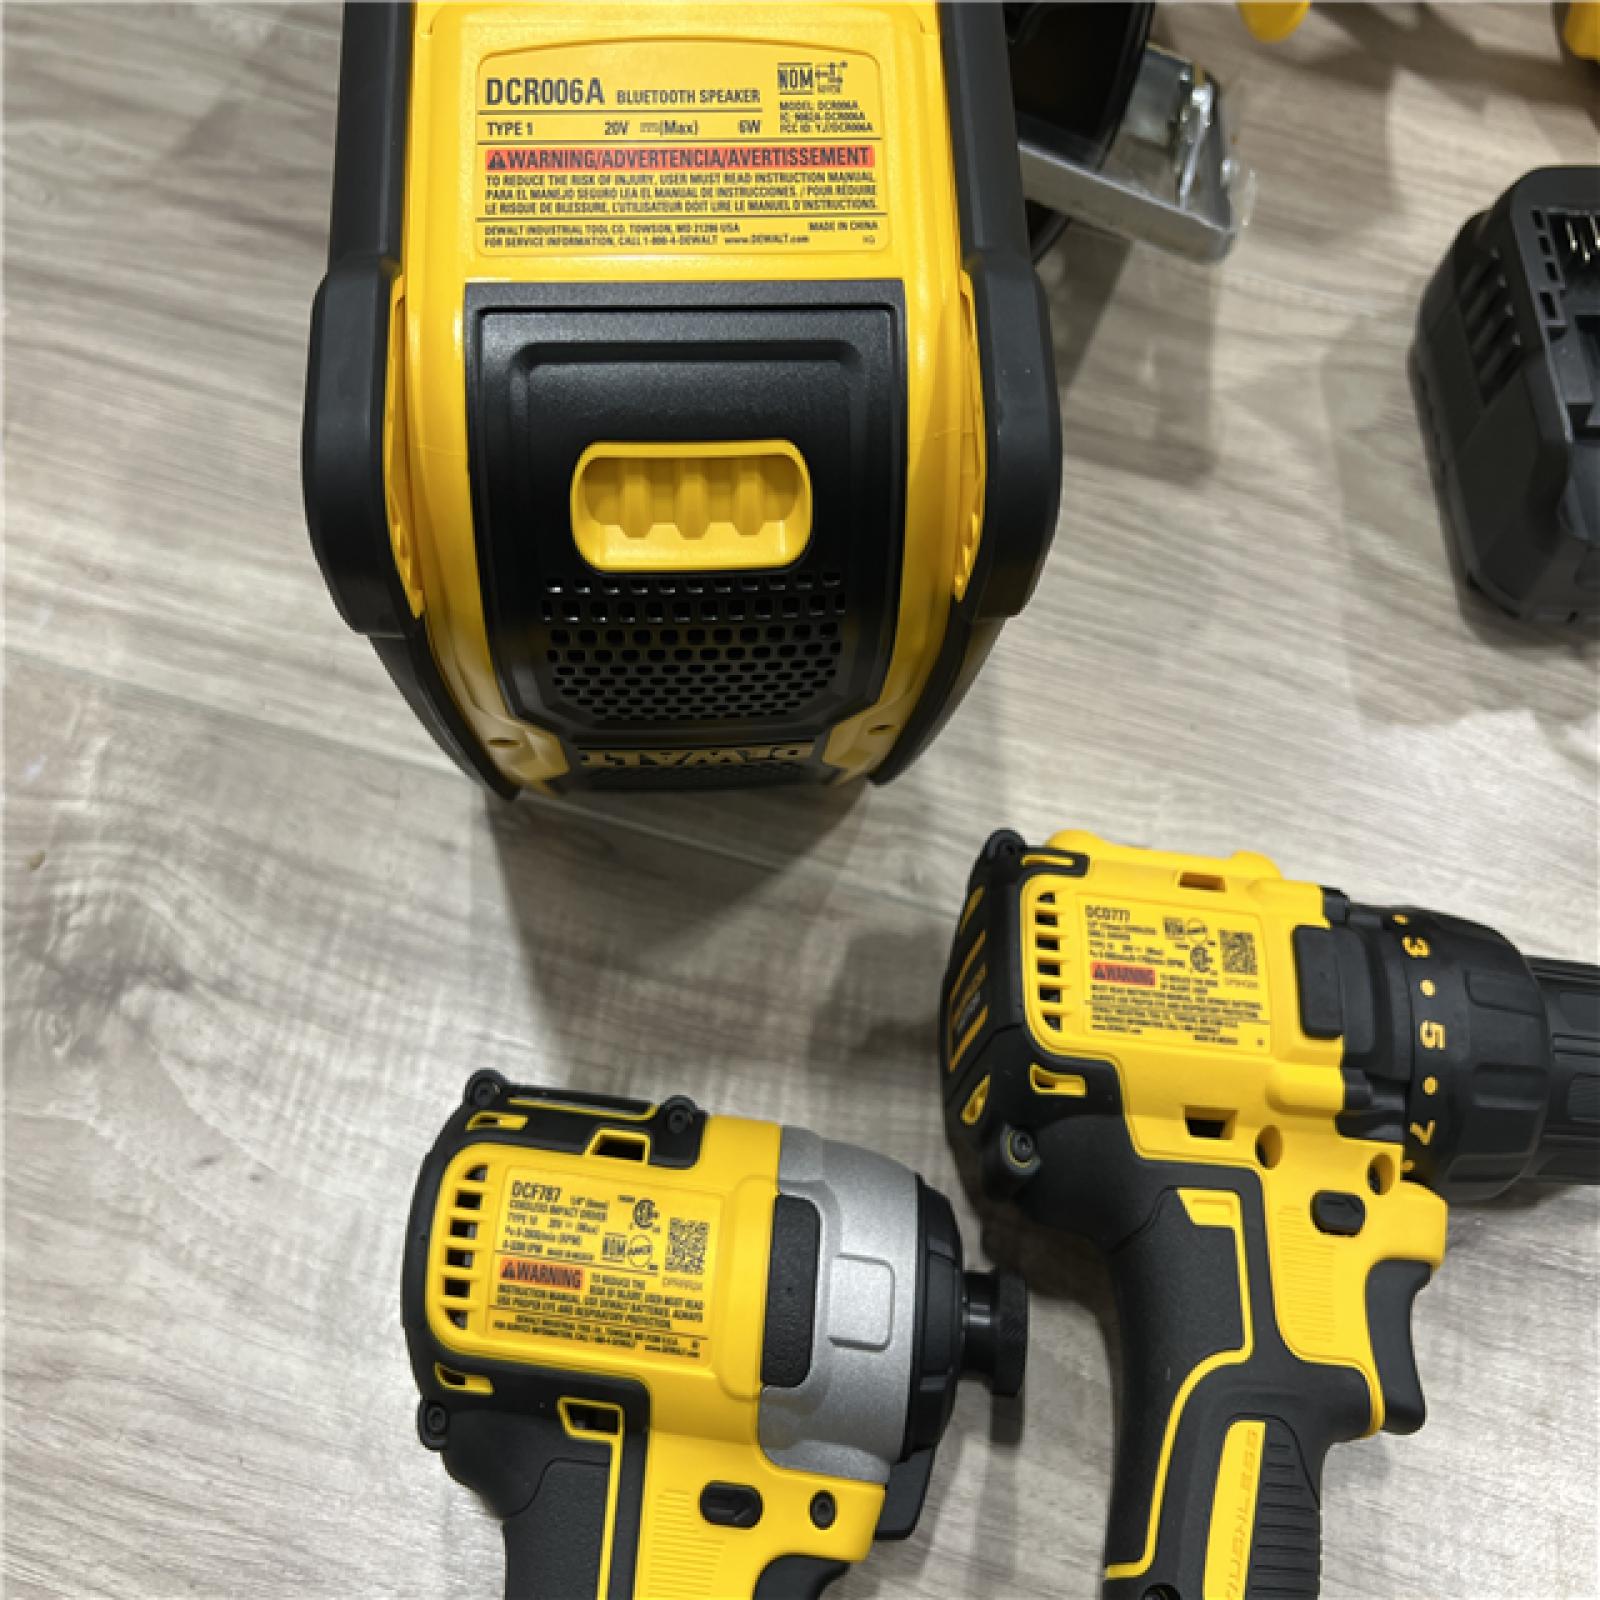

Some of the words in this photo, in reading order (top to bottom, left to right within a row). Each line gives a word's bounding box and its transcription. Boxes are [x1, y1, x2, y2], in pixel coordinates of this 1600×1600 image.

[487, 77, 605, 105] DCR006A
[616, 89, 696, 105] BLUETOOTH
[699, 88, 760, 104] SPEAKER
[778, 68, 813, 91] NOM
[487, 121, 522, 136] TYPE
[527, 121, 533, 136] 1
[605, 120, 629, 136] 20V
[660, 119, 698, 137] (Max)
[738, 119, 761, 134] 6W
[507, 147, 869, 170] WARNING/ADVERTENCIA/AVERTISSEMENT
[487, 175, 500, 186] TO
[503, 174, 544, 186] REDUCE
[549, 174, 567, 185] THE
[571, 174, 596, 185] RISK
[598, 174, 611, 185] OF
[659, 173, 687, 184] USER
[690, 173, 721, 184] MUST
[724, 172, 752, 184] READ
[755, 172, 825, 183] INSTRUCTION
[486, 190, 513, 200] PARA
[516, 189, 528, 200] EL
[530, 189, 574, 199] MANEJO
[620, 188, 637, 198] LEA
[640, 188, 651, 198] EL
[654, 187, 698, 198] MANUAL
[700, 187, 713, 197] DE
[486, 203, 496, 214] LE
[500, 202, 536, 214] RISQUE
[539, 202, 552, 213] DE
[685, 200, 708, 211] DOIT
[710, 200, 731, 211] LIRE
[734, 200, 746, 211] LE
[748, 199, 791, 211] MANUEL
[485, 226, 523, 236] DEWALT
[526, 225, 583, 236] INDUSTRIAL
[585, 225, 609, 235] TOOL
[720, 223, 740, 233] USA
[808, 221, 837, 231] MADE
[838, 221, 849, 231] IN
[850, 220, 879, 230] CHINA
[485, 238, 503, 248] FOR
[505, 237, 544, 248] SERVICE
[618, 236, 642, 246] CALL
[1402, 935, 1431, 958] 3
[1419, 1019, 1446, 1051] 5
[1409, 1118, 1436, 1146] 7
[511, 1180, 562, 1203] DCF787
[516, 1260, 582, 1290] WARNING
